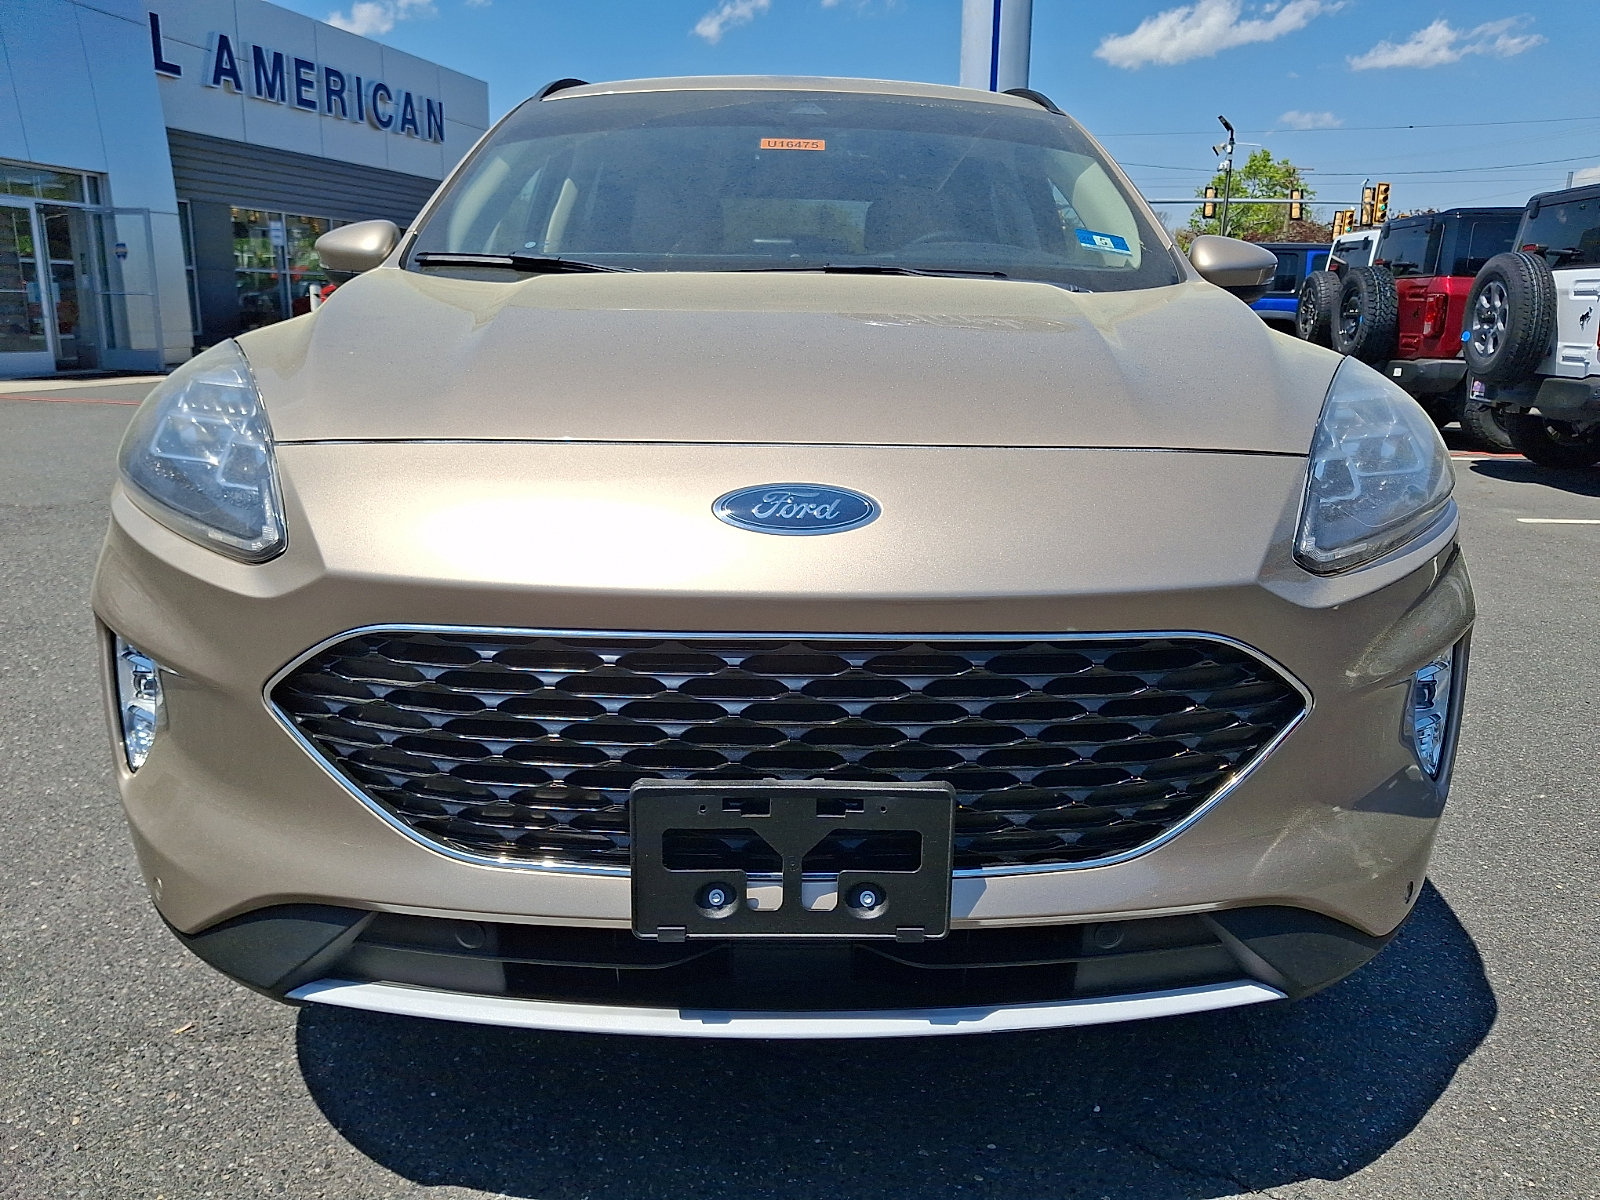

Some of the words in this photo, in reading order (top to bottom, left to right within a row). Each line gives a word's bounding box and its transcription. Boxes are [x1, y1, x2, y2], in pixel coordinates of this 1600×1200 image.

[210, 33, 445, 143] AMERICAN
[767, 140, 819, 149] U16475
[752, 491, 840, 520] Ford
